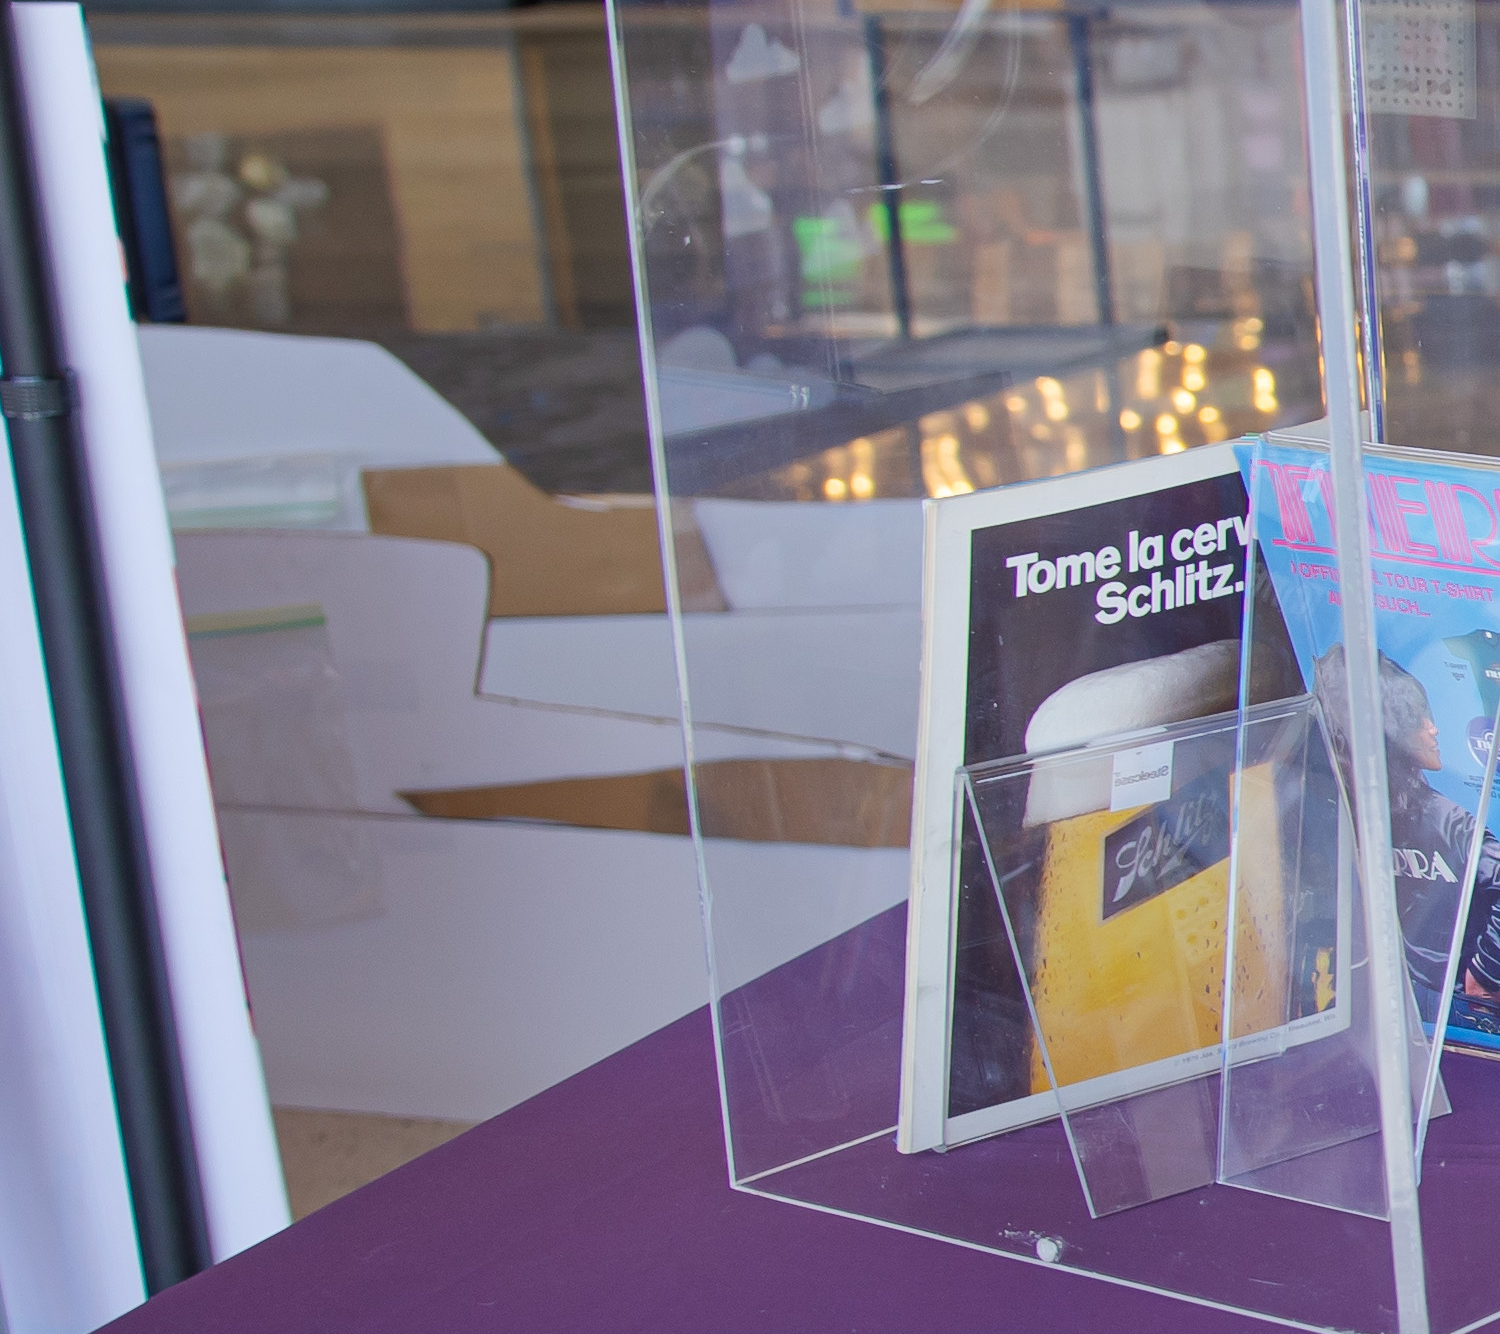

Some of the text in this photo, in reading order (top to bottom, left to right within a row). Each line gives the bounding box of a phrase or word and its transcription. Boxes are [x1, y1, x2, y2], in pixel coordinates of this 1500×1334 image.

[1005, 545, 1123, 598] Tome
[1128, 529, 1164, 573] la
[1094, 560, 1245, 625] Schlitz.
[1383, 572, 1429, 595] TOUR
[1430, 579, 1494, 603] T-SHIRT
